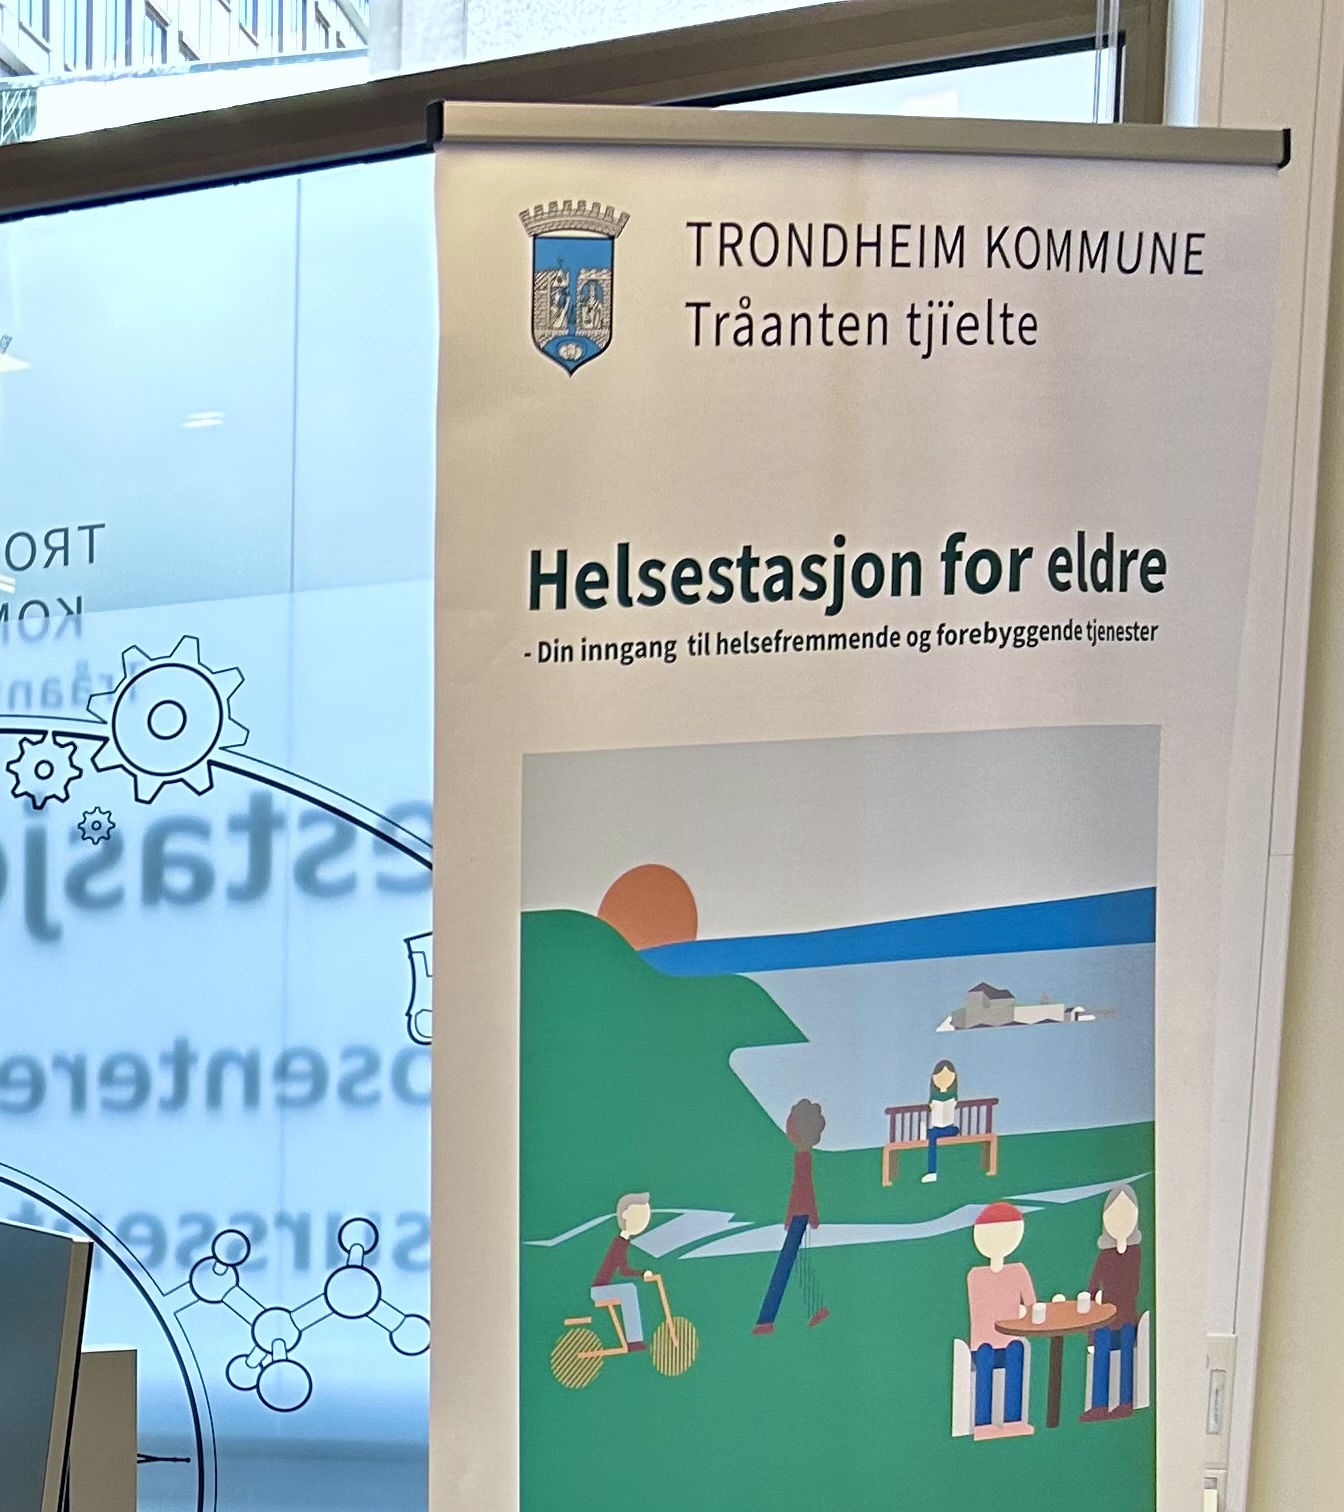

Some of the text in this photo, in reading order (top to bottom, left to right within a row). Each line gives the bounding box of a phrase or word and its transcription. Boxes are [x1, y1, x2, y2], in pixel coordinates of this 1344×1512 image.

[687, 222, 1205, 275] TRONDHEIM KOMMUNE
[685, 296, 1037, 359] Tråanten tjïelte
[530, 531, 1166, 616] Helsestasjon for eldre
[538, 639, 573, 663] Din
[582, 638, 676, 665] inngang
[688, 632, 710, 656] til
[717, 625, 900, 655] helsefremmende
[907, 630, 931, 653] og
[937, 619, 1082, 649] forebyggende
[1087, 619, 1158, 647] tjenester
